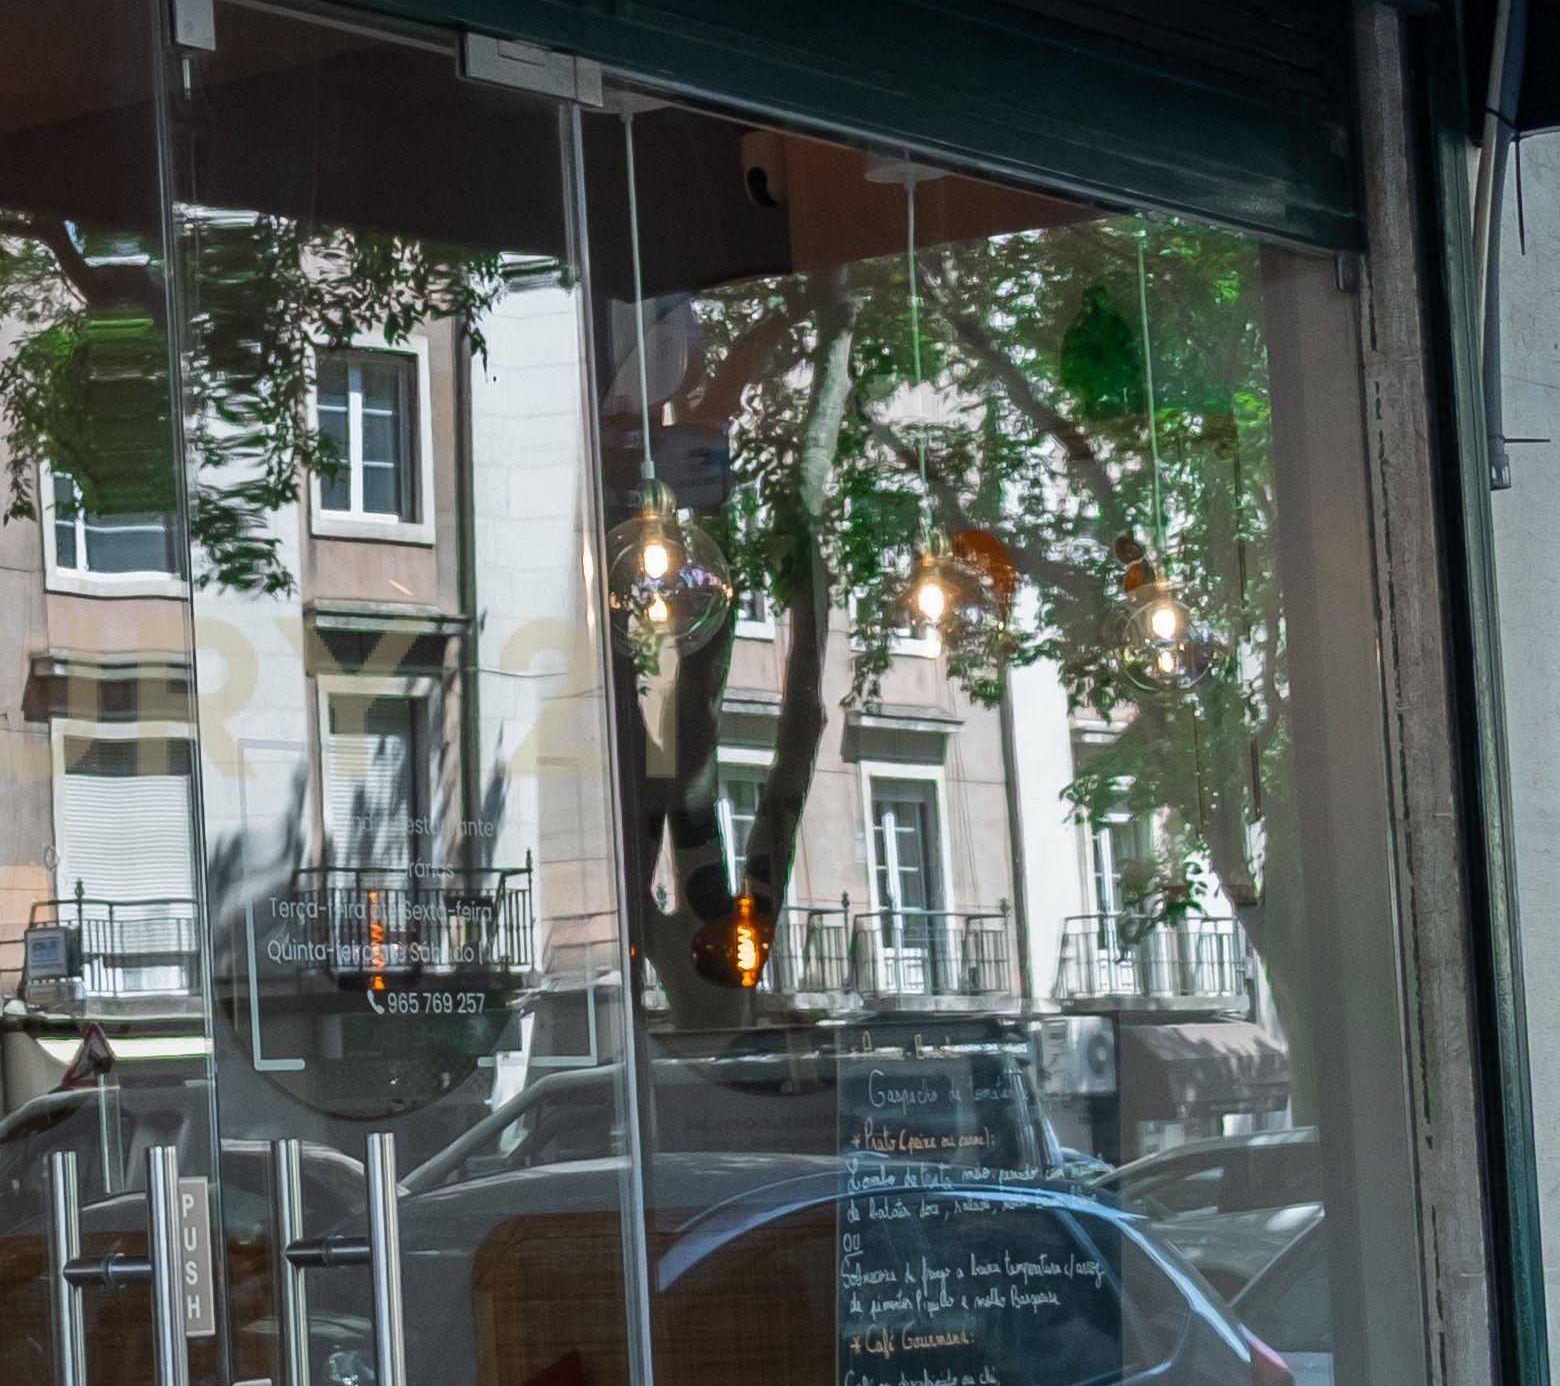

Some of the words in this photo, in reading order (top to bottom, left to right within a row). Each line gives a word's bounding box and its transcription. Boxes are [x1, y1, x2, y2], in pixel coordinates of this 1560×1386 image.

[387, 993, 419, 1014] 965
[424, 993, 453, 1014] 769
[457, 993, 486, 1013] 257
[181, 1192, 202, 1320] PUSH
